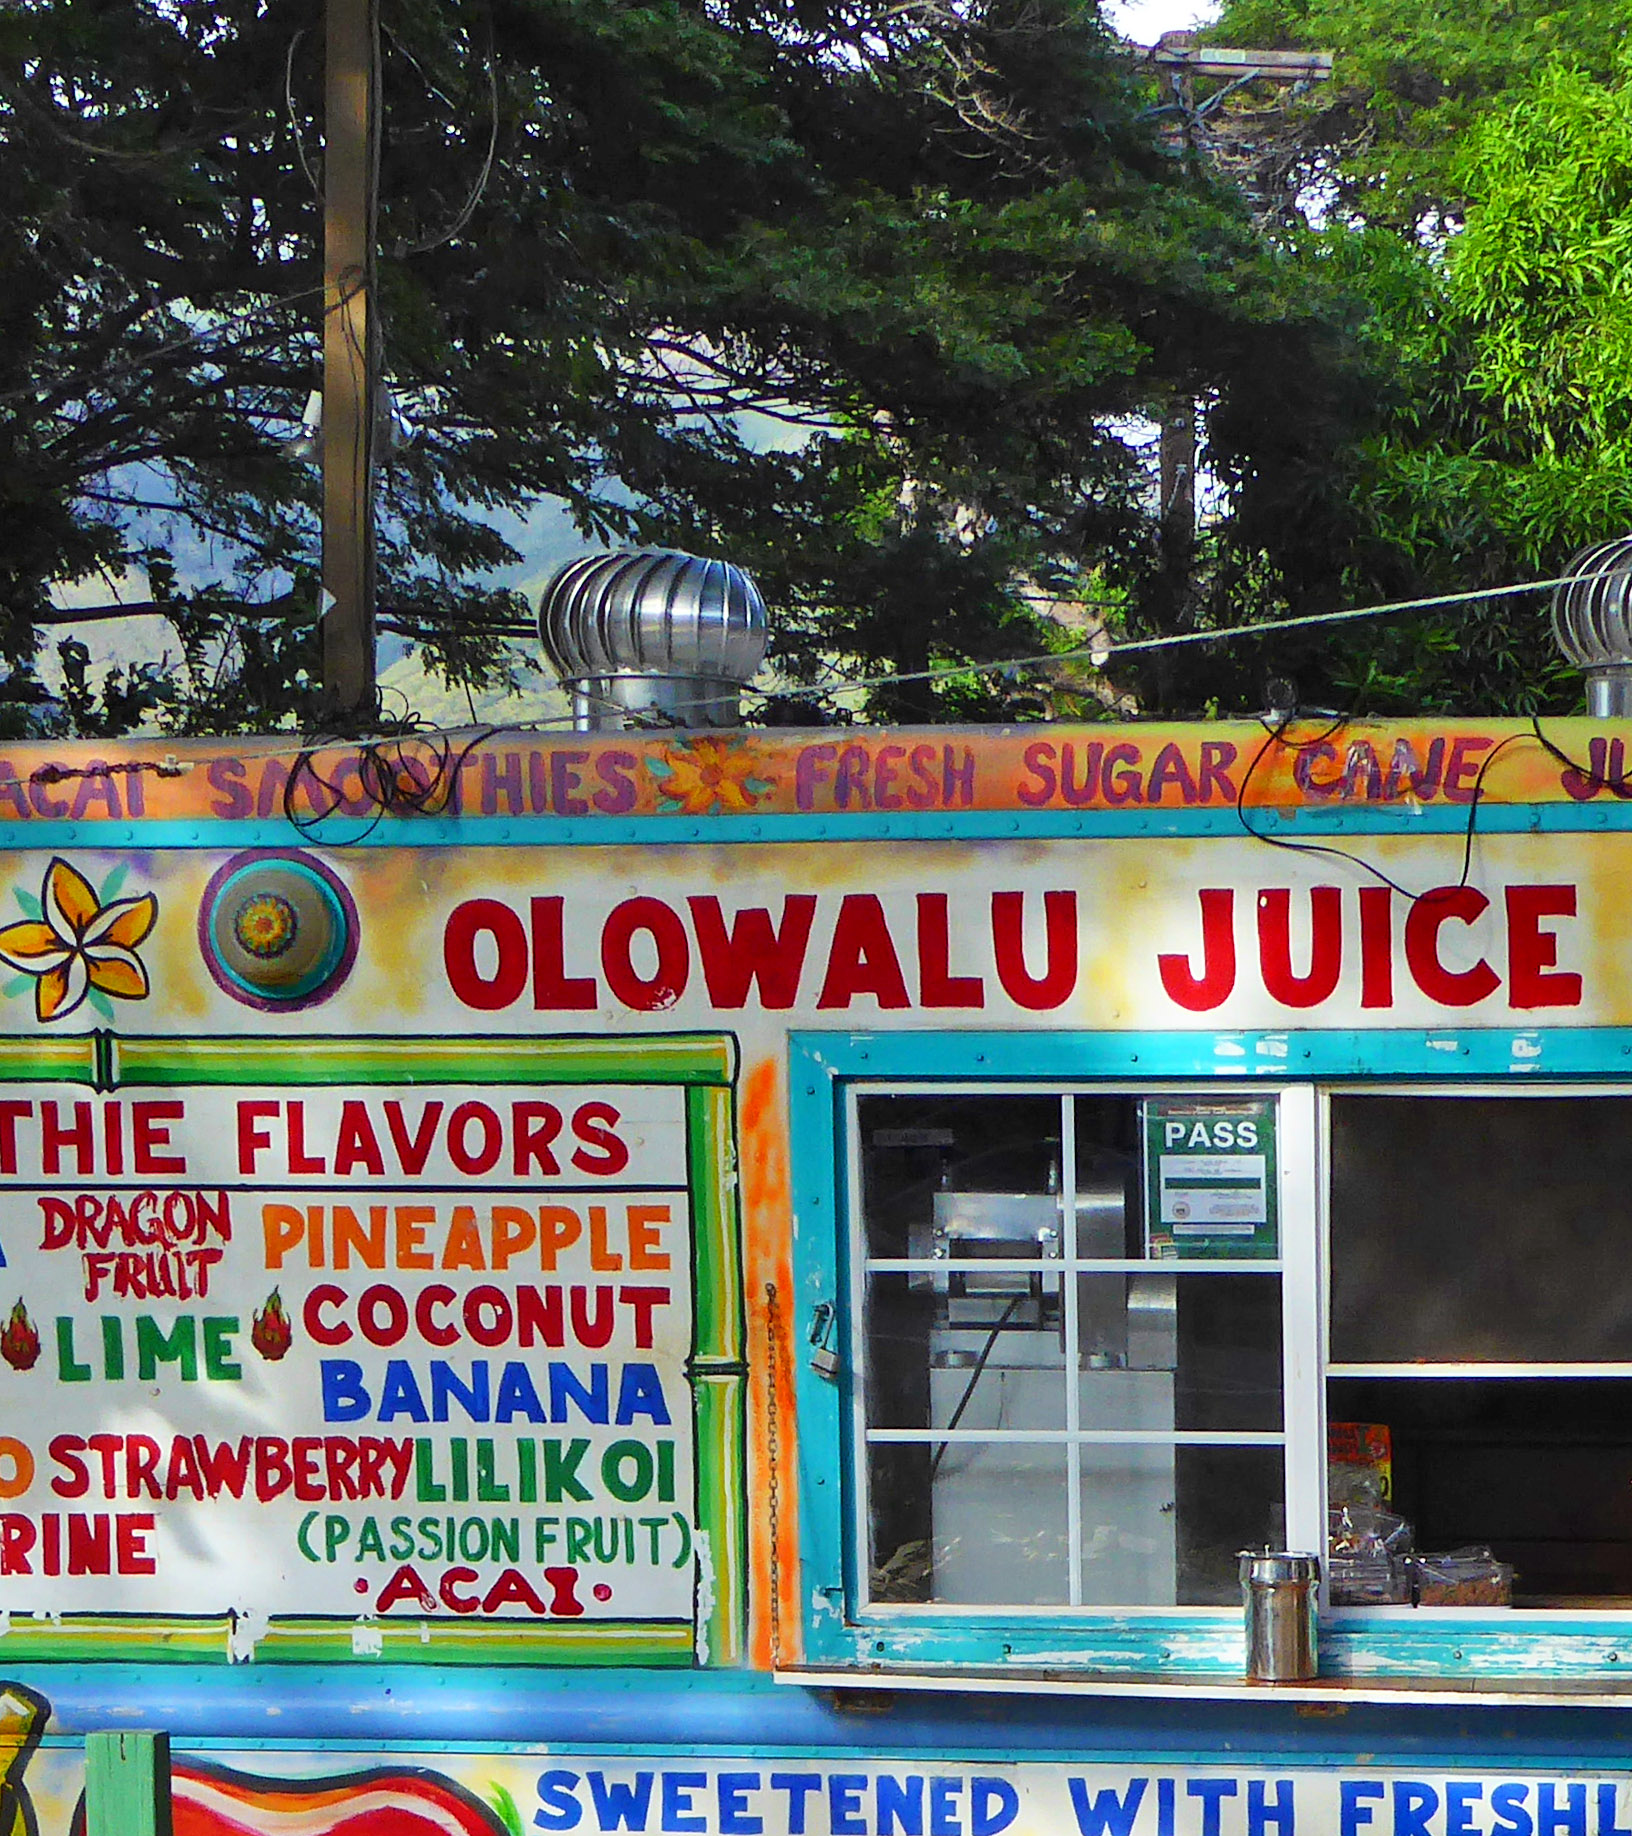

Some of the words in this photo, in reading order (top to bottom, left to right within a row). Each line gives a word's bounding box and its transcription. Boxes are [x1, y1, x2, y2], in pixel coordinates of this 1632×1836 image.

[207, 750, 637, 820] SMOOTHIES
[796, 742, 975, 811] FRESH
[1017, 741, 1239, 806] SUGAR
[1293, 736, 1494, 800] CANE
[443, 890, 1078, 1011] OLOWALU
[1158, 885, 1582, 1012] JUICE
[236, 1100, 630, 1177] FLAVORS
[1165, 1121, 1259, 1148] PASS
[37, 1191, 232, 1252] DRAGON
[262, 1203, 671, 1271] PINEAPPLE
[82, 1248, 224, 1303] FRUIT
[55, 1315, 242, 1382] LIME
[303, 1284, 671, 1349] COCONUT
[320, 1359, 671, 1425] BANANA
[48, 1433, 414, 1503] STRAWBERRY
[415, 1437, 677, 1503] LILIKOI
[298, 1511, 520, 1569] (PASSION
[536, 1511, 691, 1569] FRUIT)
